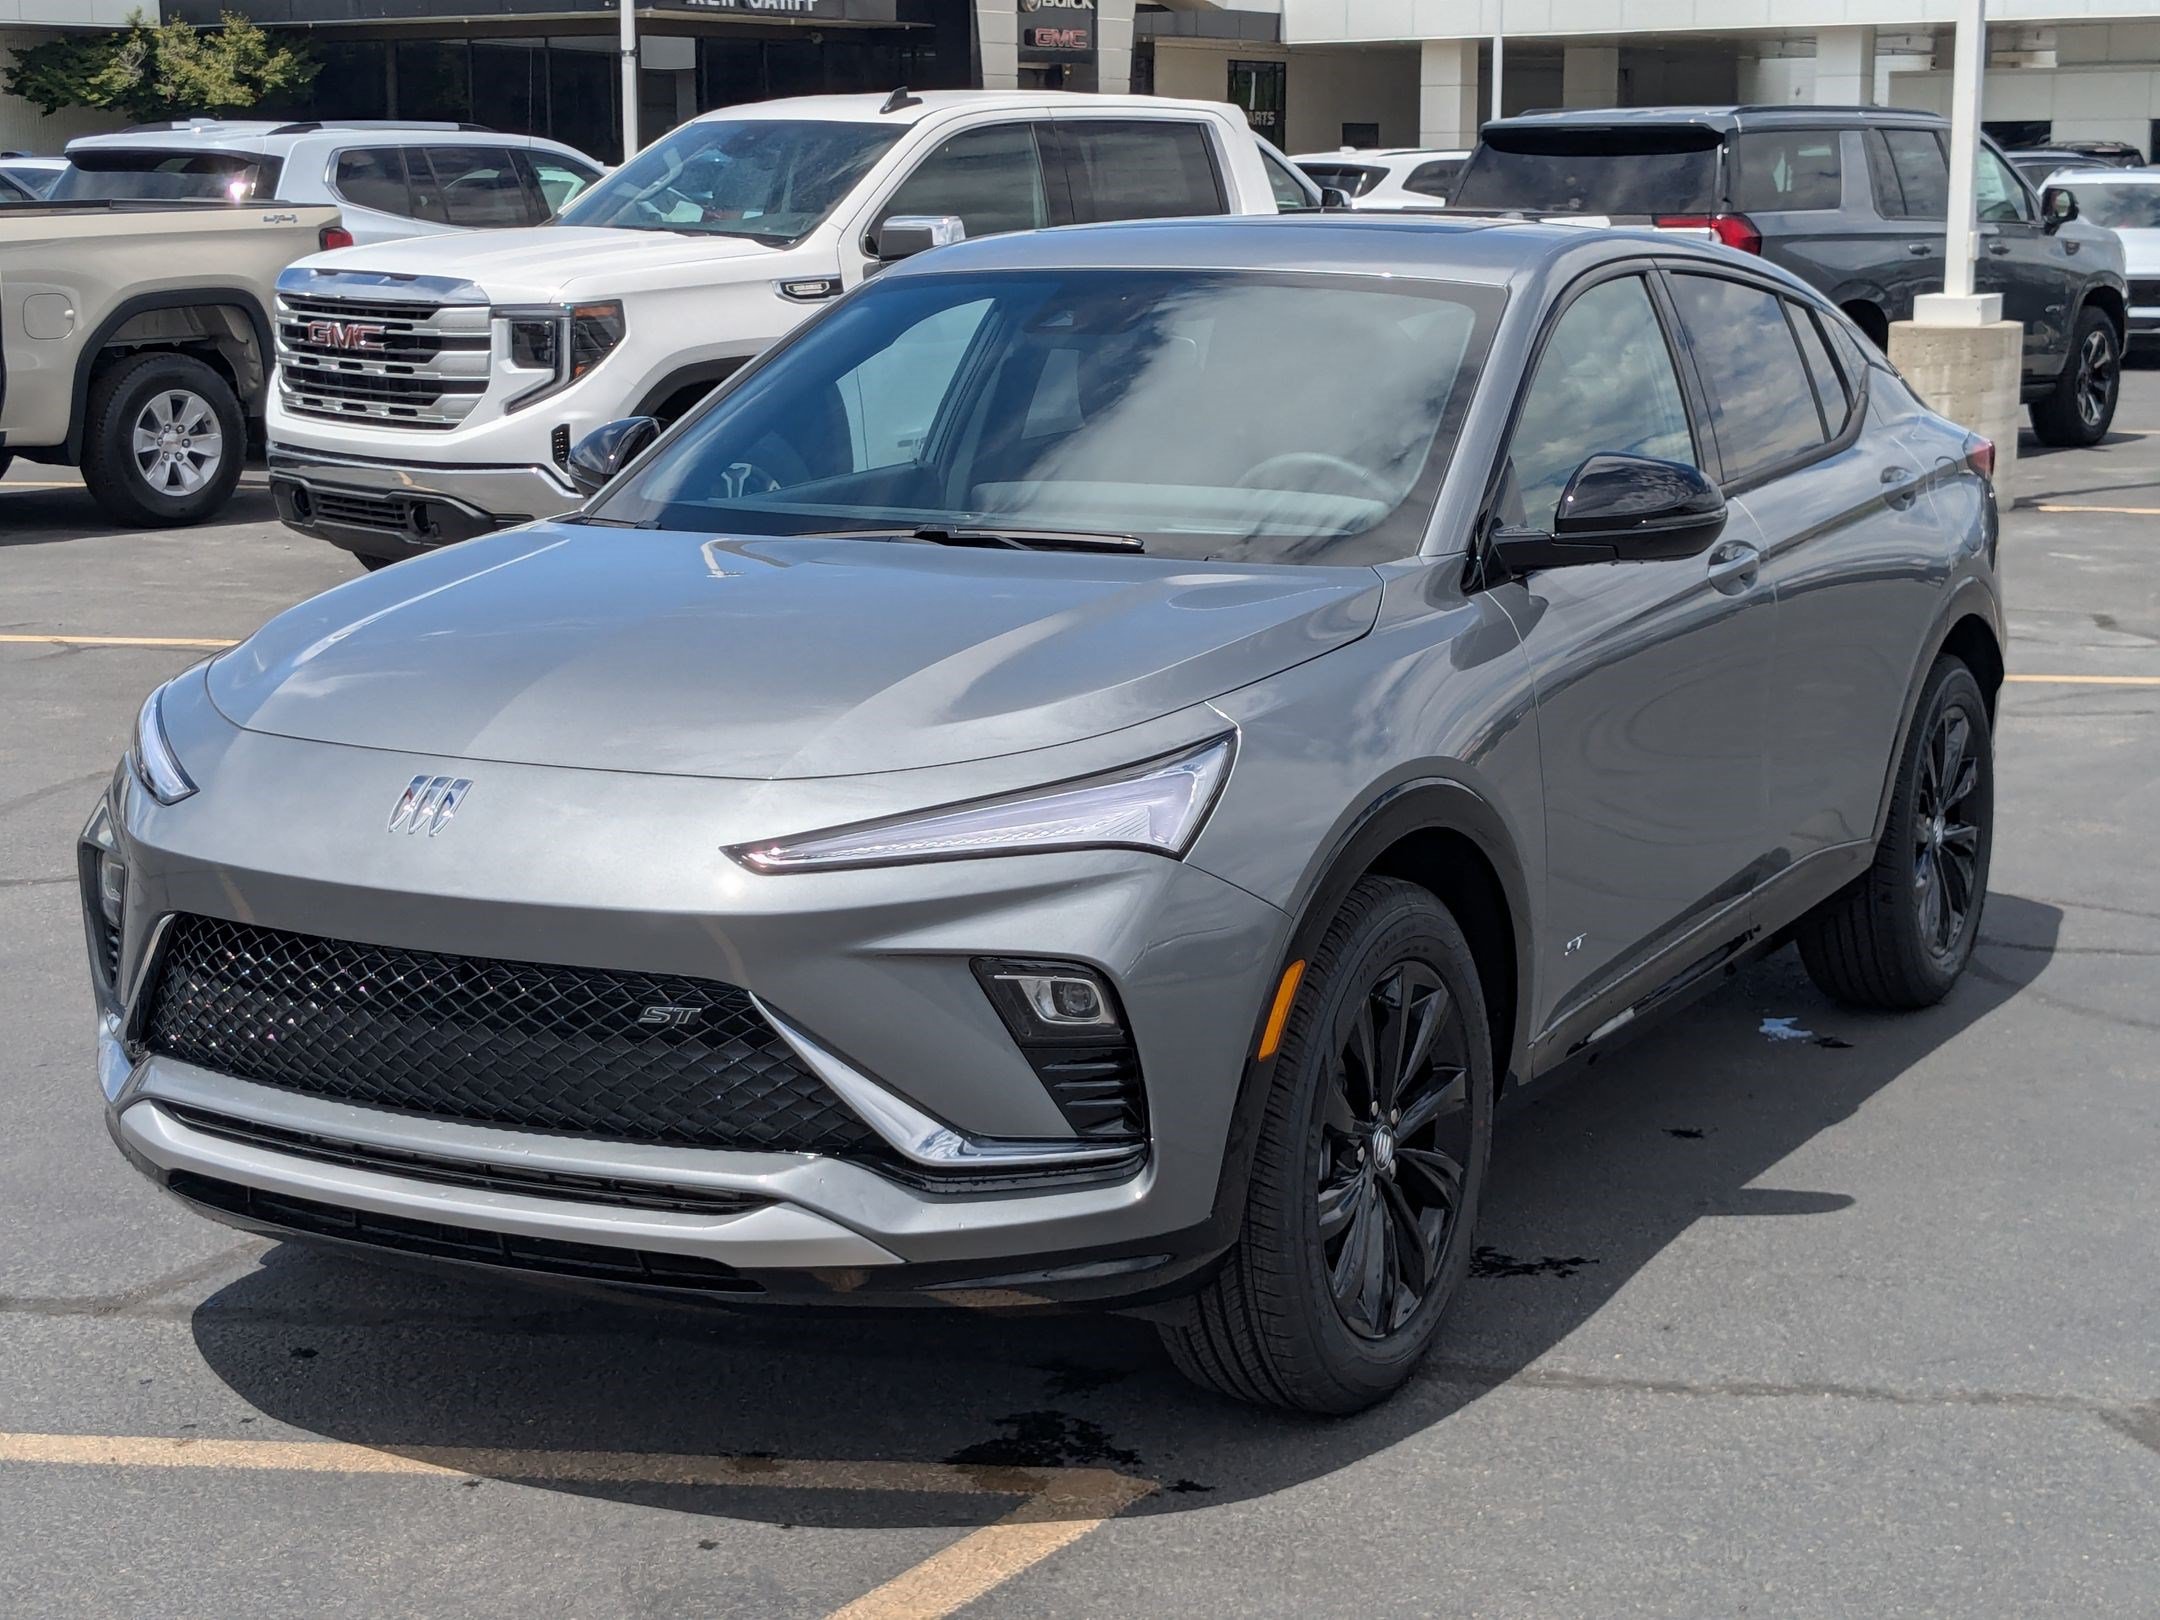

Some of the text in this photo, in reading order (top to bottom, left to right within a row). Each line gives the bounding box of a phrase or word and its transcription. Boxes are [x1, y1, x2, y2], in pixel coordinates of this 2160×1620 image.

[1035, 28, 1087, 48] GMC
[308, 320, 385, 352] GMC
[639, 1006, 702, 1025] ST
